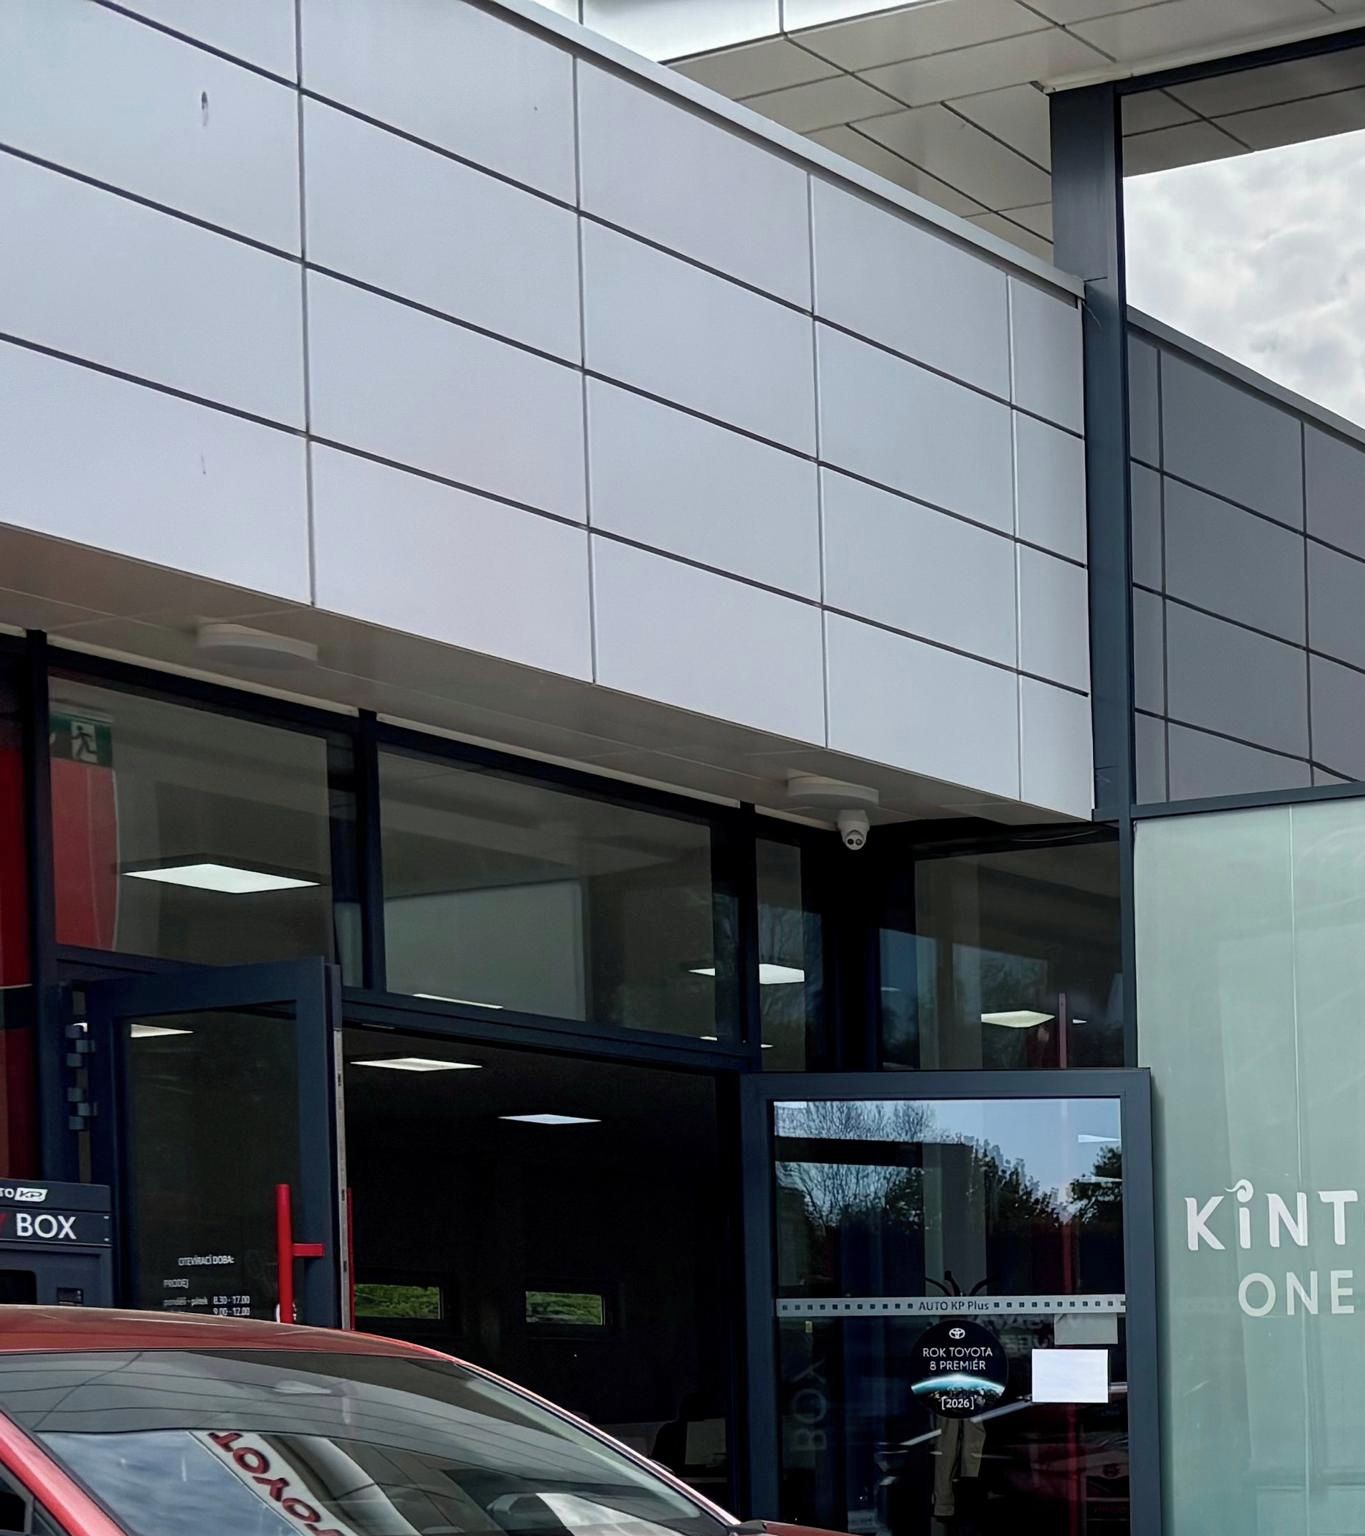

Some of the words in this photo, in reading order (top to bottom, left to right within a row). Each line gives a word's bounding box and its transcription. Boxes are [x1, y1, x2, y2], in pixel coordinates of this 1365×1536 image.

[16, 1213, 77, 1240] BOX
[1238, 1270, 1356, 1318] ONE
[918, 1300, 948, 1311] AUTO
[952, 1300, 965, 1311] KP
[968, 1300, 989, 1311] Plus
[922, 1347, 946, 1358] ROK
[949, 1347, 993, 1357] TOYOTA
[929, 1361, 937, 1371] 8
[940, 1359, 986, 1371] PREMIÉR
[941, 1398, 974, 1410] [2026]
